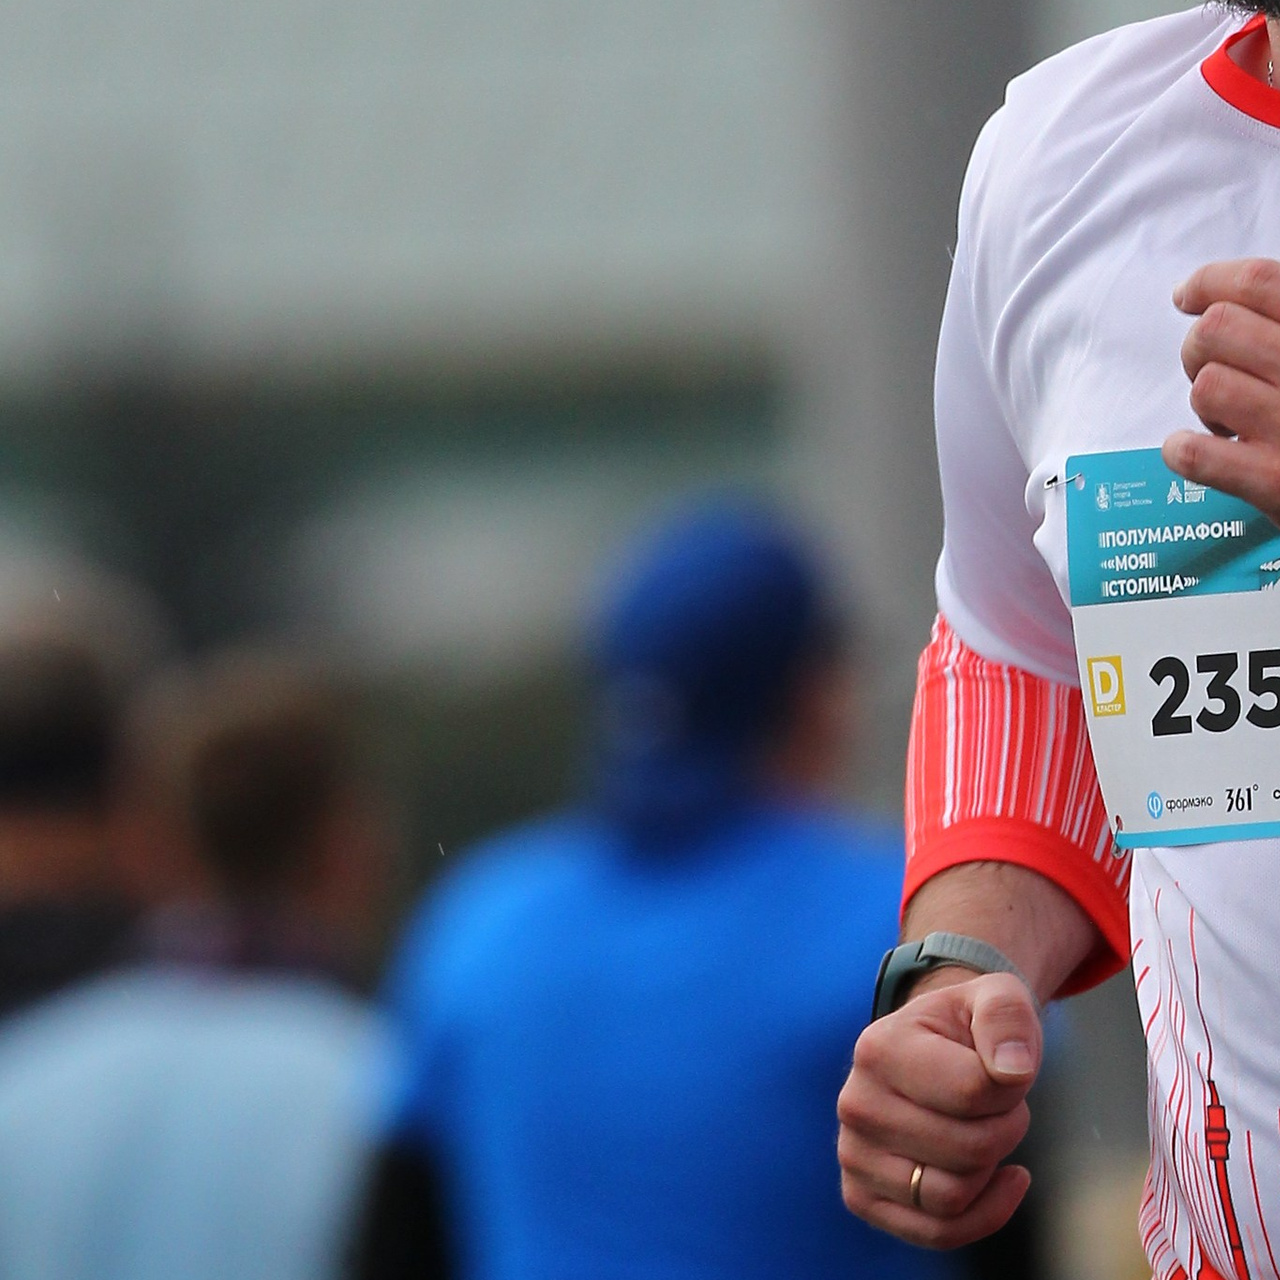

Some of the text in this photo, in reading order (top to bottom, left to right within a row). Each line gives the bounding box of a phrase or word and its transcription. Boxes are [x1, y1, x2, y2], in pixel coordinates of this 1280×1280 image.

[1103, 520, 1238, 548] ПОЛУМАРАФОН
[1091, 661, 1119, 704] D
[1165, 795, 1214, 813] формэко
